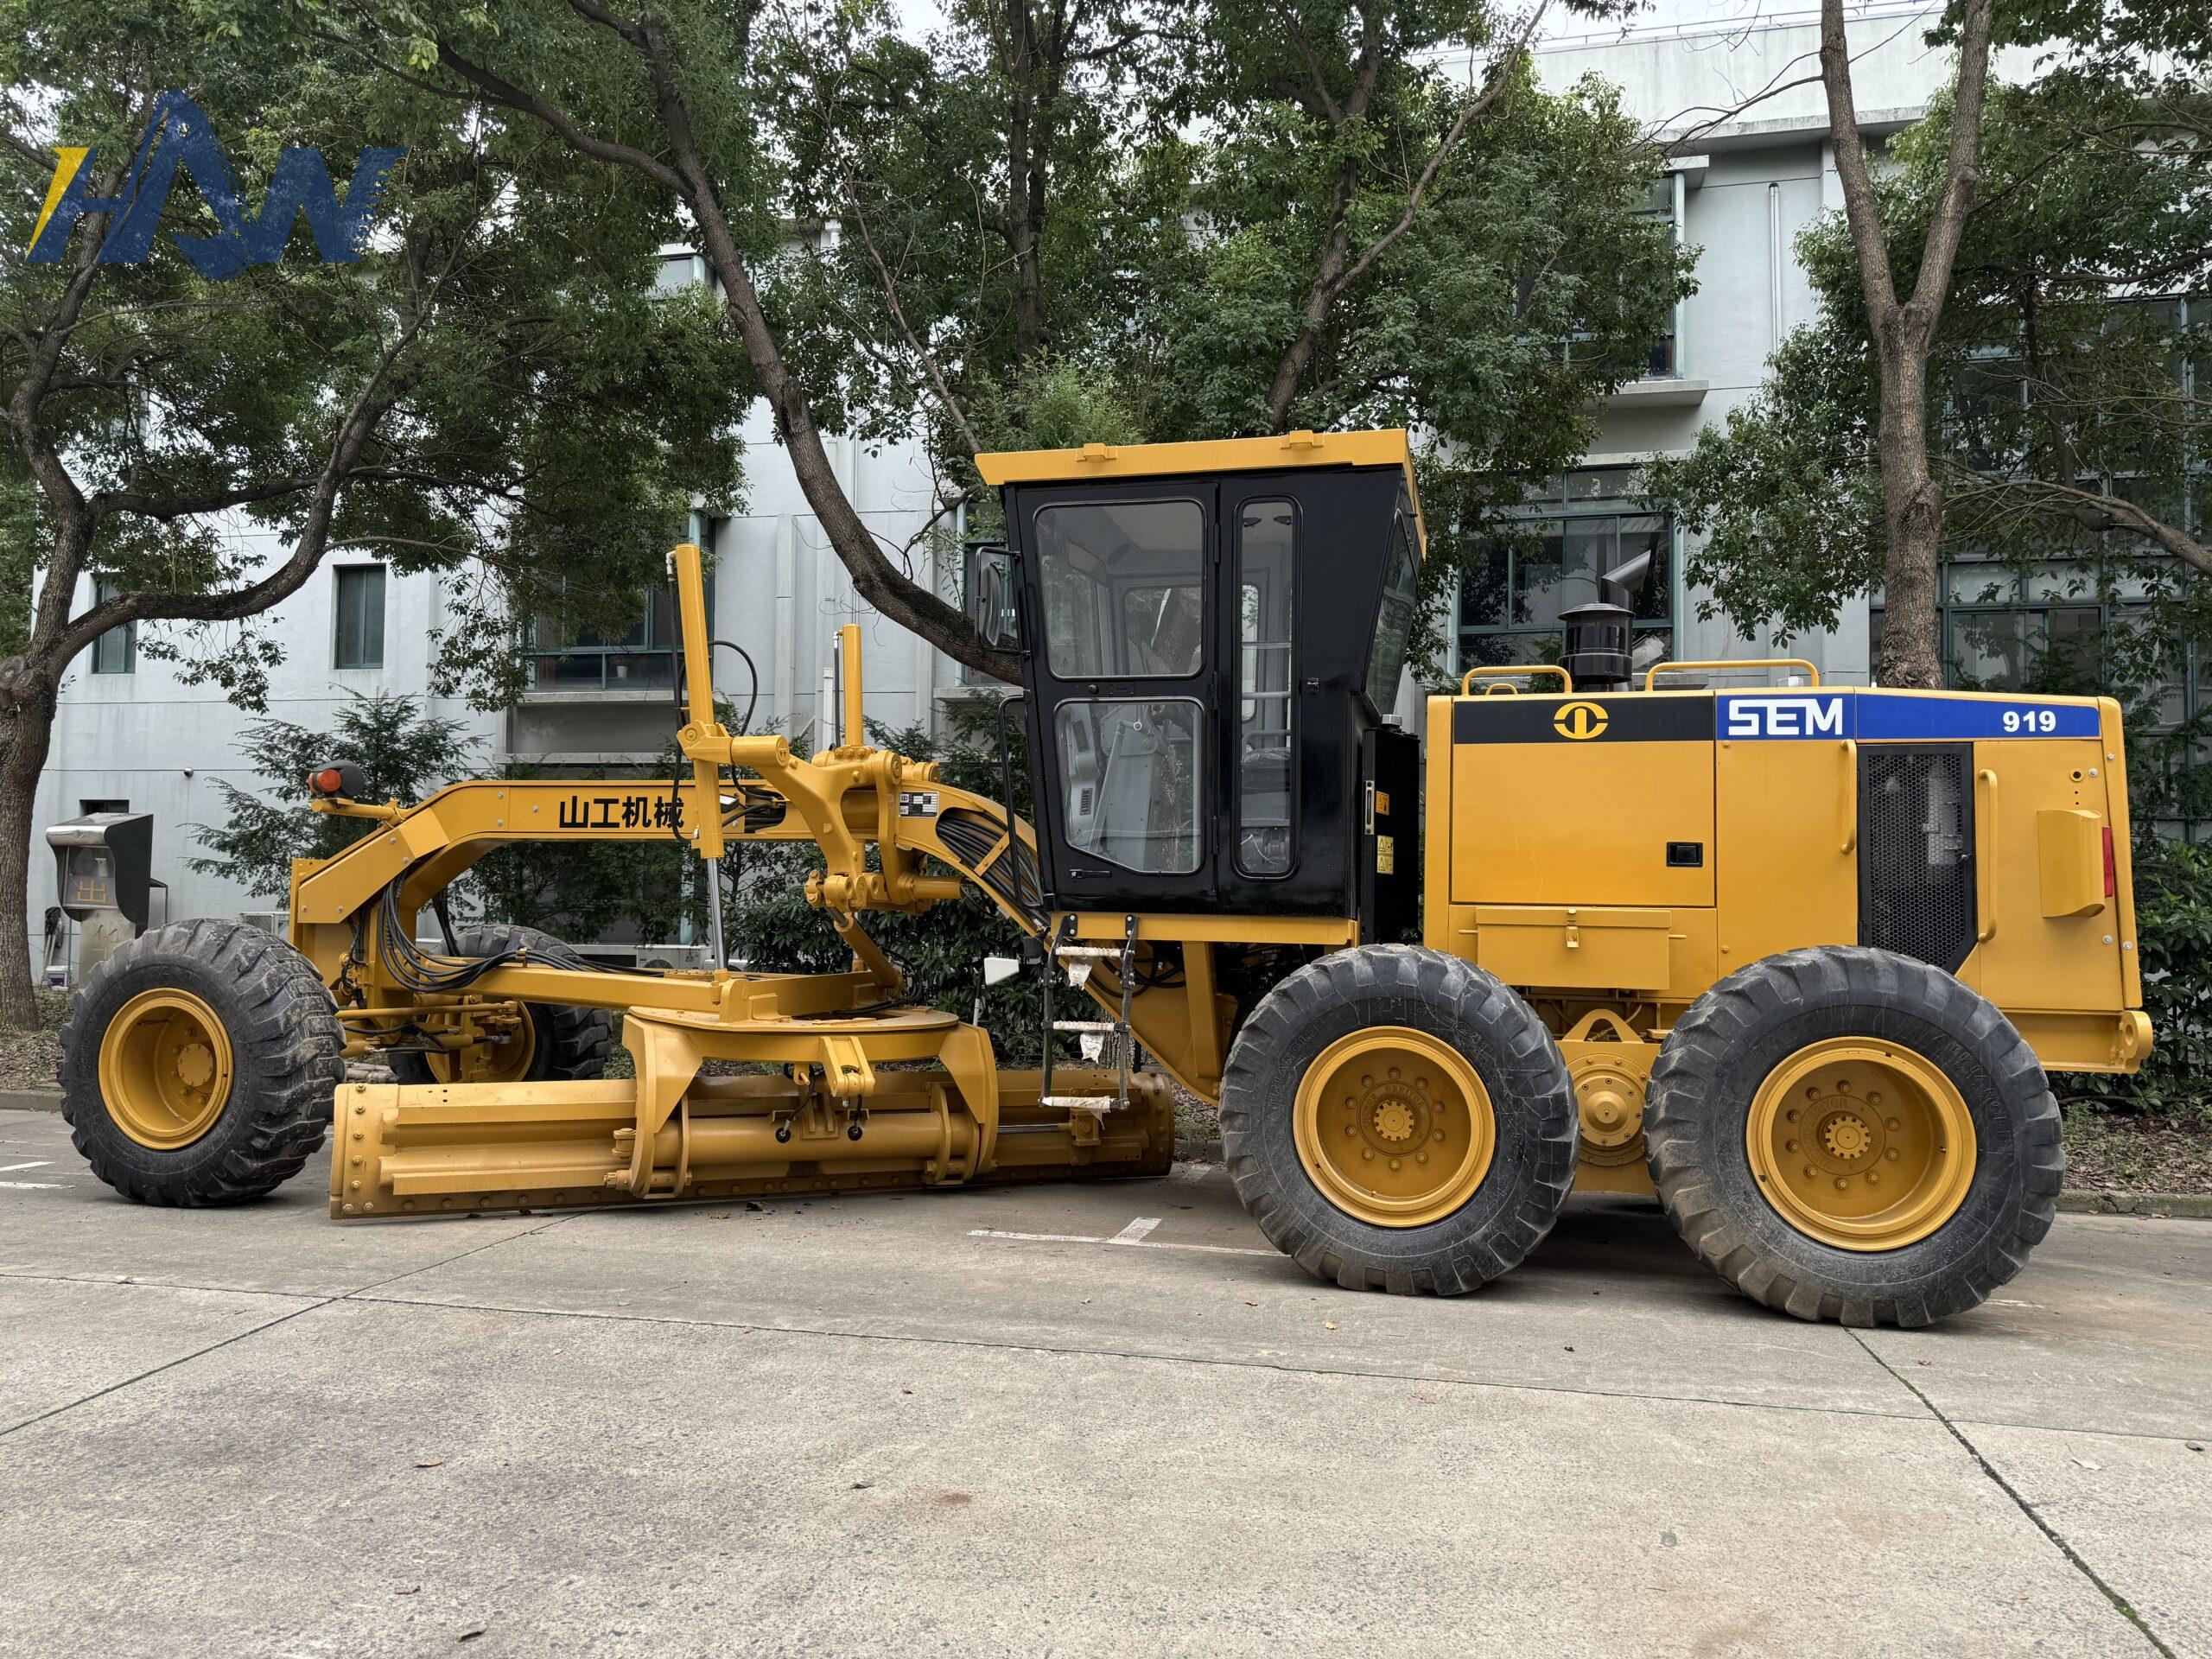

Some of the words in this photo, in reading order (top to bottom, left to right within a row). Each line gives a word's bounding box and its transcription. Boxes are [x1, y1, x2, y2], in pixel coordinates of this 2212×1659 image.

[1727, 697, 1843, 736] SEM
[2002, 710, 2057, 733] 919
[559, 795, 684, 829] 山工机械
[77, 879, 107, 905] 出
